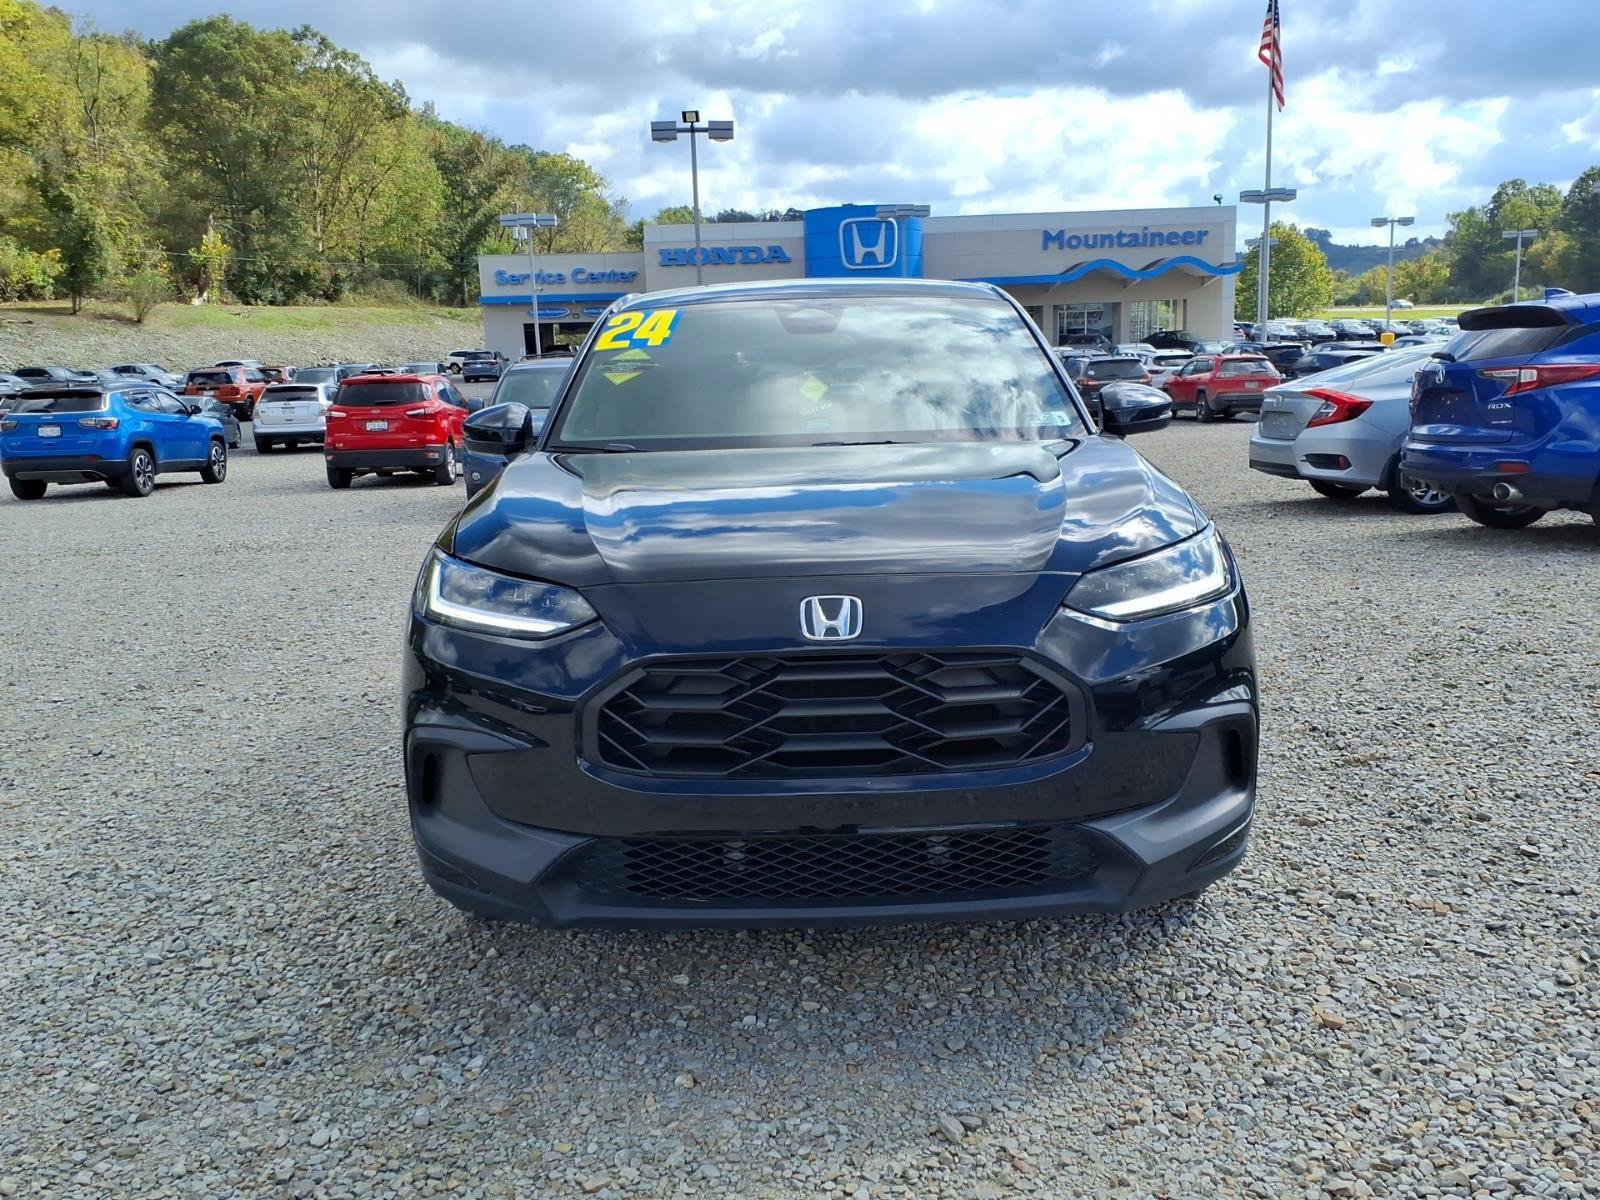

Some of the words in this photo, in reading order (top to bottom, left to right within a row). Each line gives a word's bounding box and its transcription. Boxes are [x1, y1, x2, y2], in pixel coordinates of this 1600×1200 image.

[1042, 226, 1209, 251] Mountaineer
[658, 245, 792, 267] HONDA
[494, 268, 566, 286] Service
[571, 267, 639, 284] Center
[594, 309, 679, 351] 24
[1487, 402, 1512, 410] RDX
